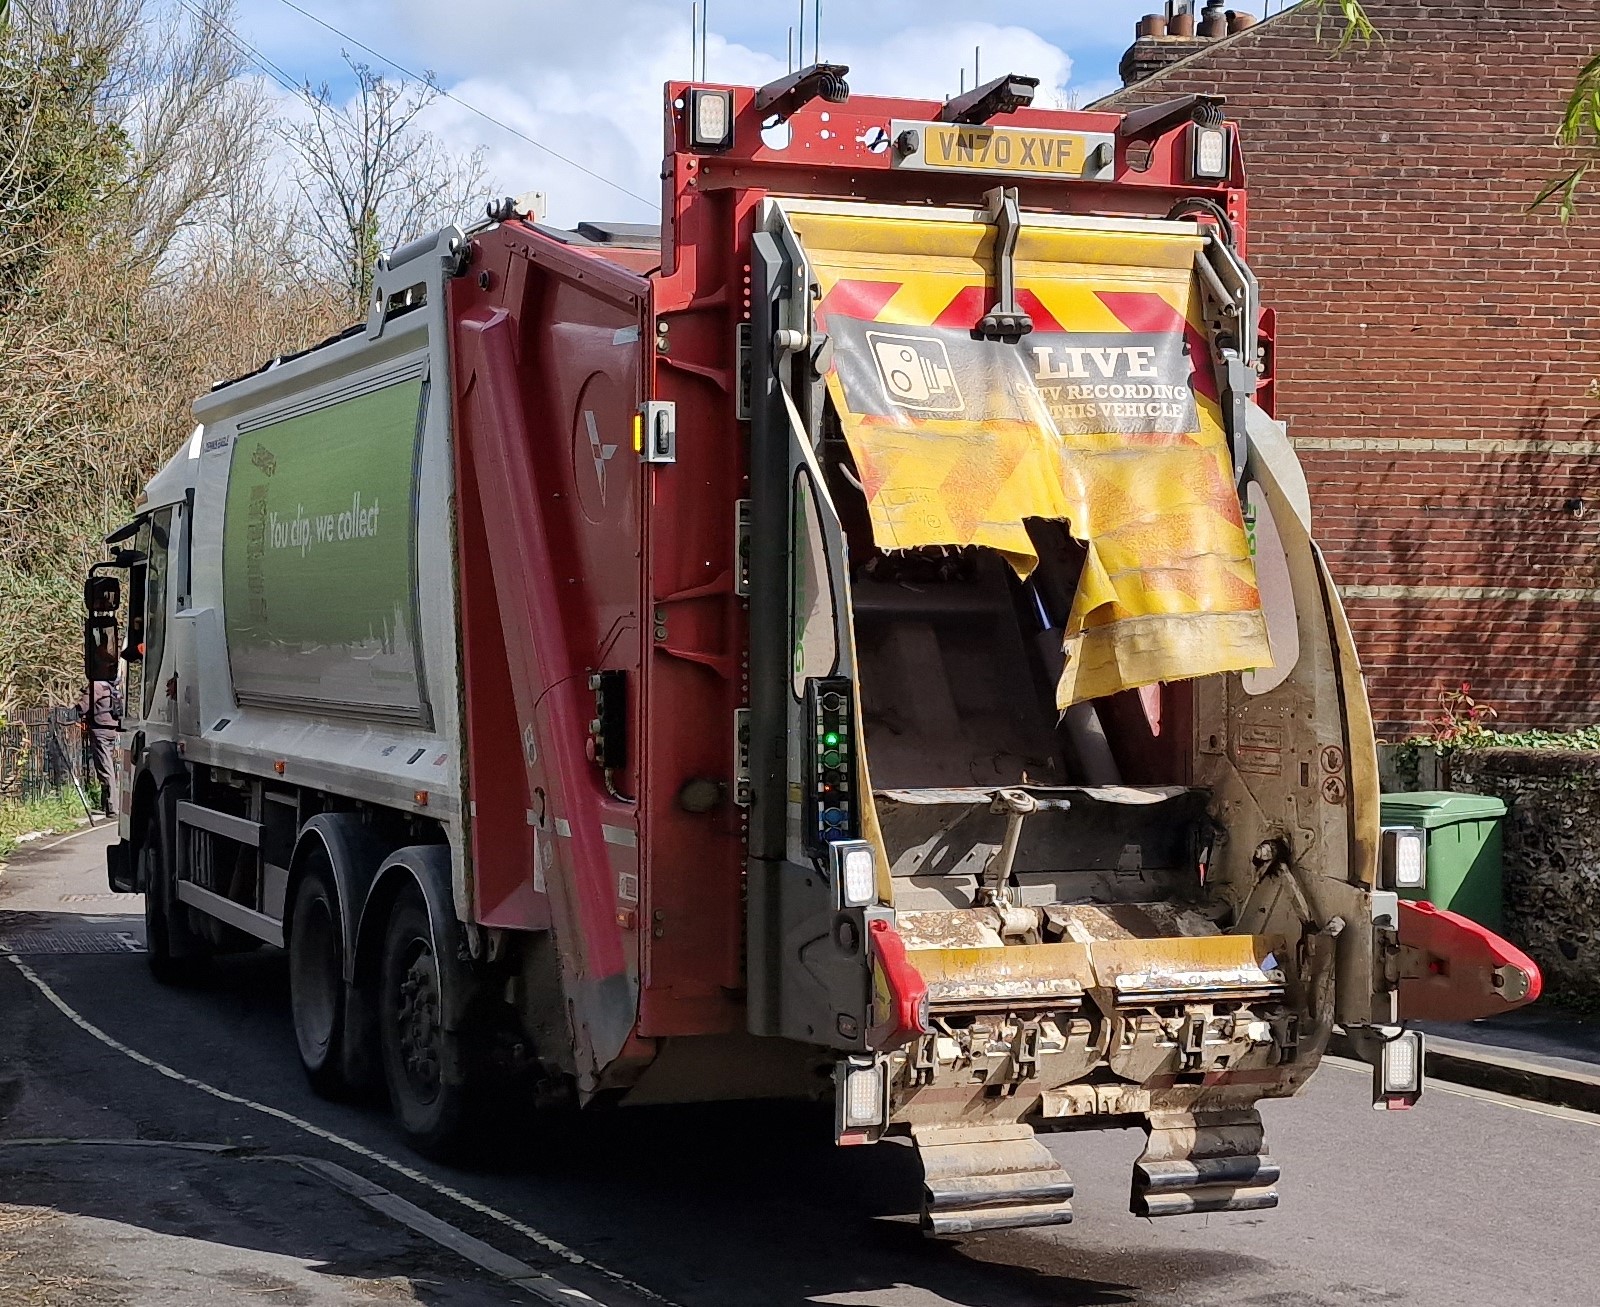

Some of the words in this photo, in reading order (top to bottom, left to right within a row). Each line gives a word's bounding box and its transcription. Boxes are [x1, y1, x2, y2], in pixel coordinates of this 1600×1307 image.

[939, 131, 1010, 164] VN70
[1020, 136, 1073, 167] XVF
[1032, 346, 1158, 380] LIVE
[1015, 381, 1063, 401] CTV
[1068, 384, 1188, 401] RECORDING
[1050, 402, 1096, 418] THIS
[1098, 402, 1184, 418] VEHICLE
[269, 511, 289, 549] You
[290, 503, 312, 558] clip,
[316, 514, 334, 543] we
[338, 491, 380, 541] collect
